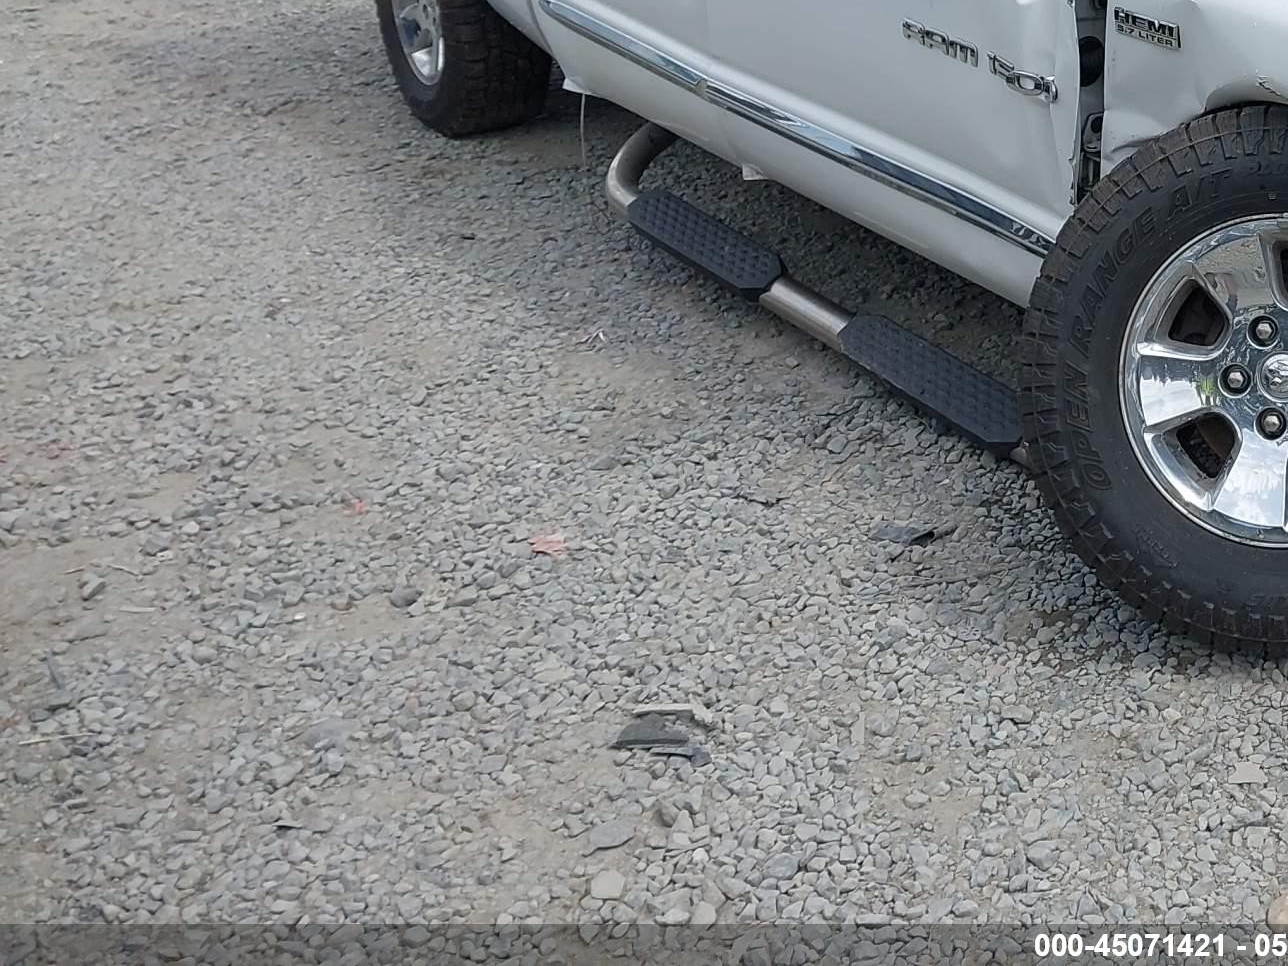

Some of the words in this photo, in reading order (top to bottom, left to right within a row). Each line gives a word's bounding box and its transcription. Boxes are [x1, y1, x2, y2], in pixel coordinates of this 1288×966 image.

[902, 17, 979, 68] RAM
[1113, 6, 1178, 39] HEMI
[1117, 23, 1135, 35] 5.7
[1138, 31, 1173, 48] LITER
[1068, 206, 1158, 360] RANGE
[1063, 360, 1113, 491] OPEN
